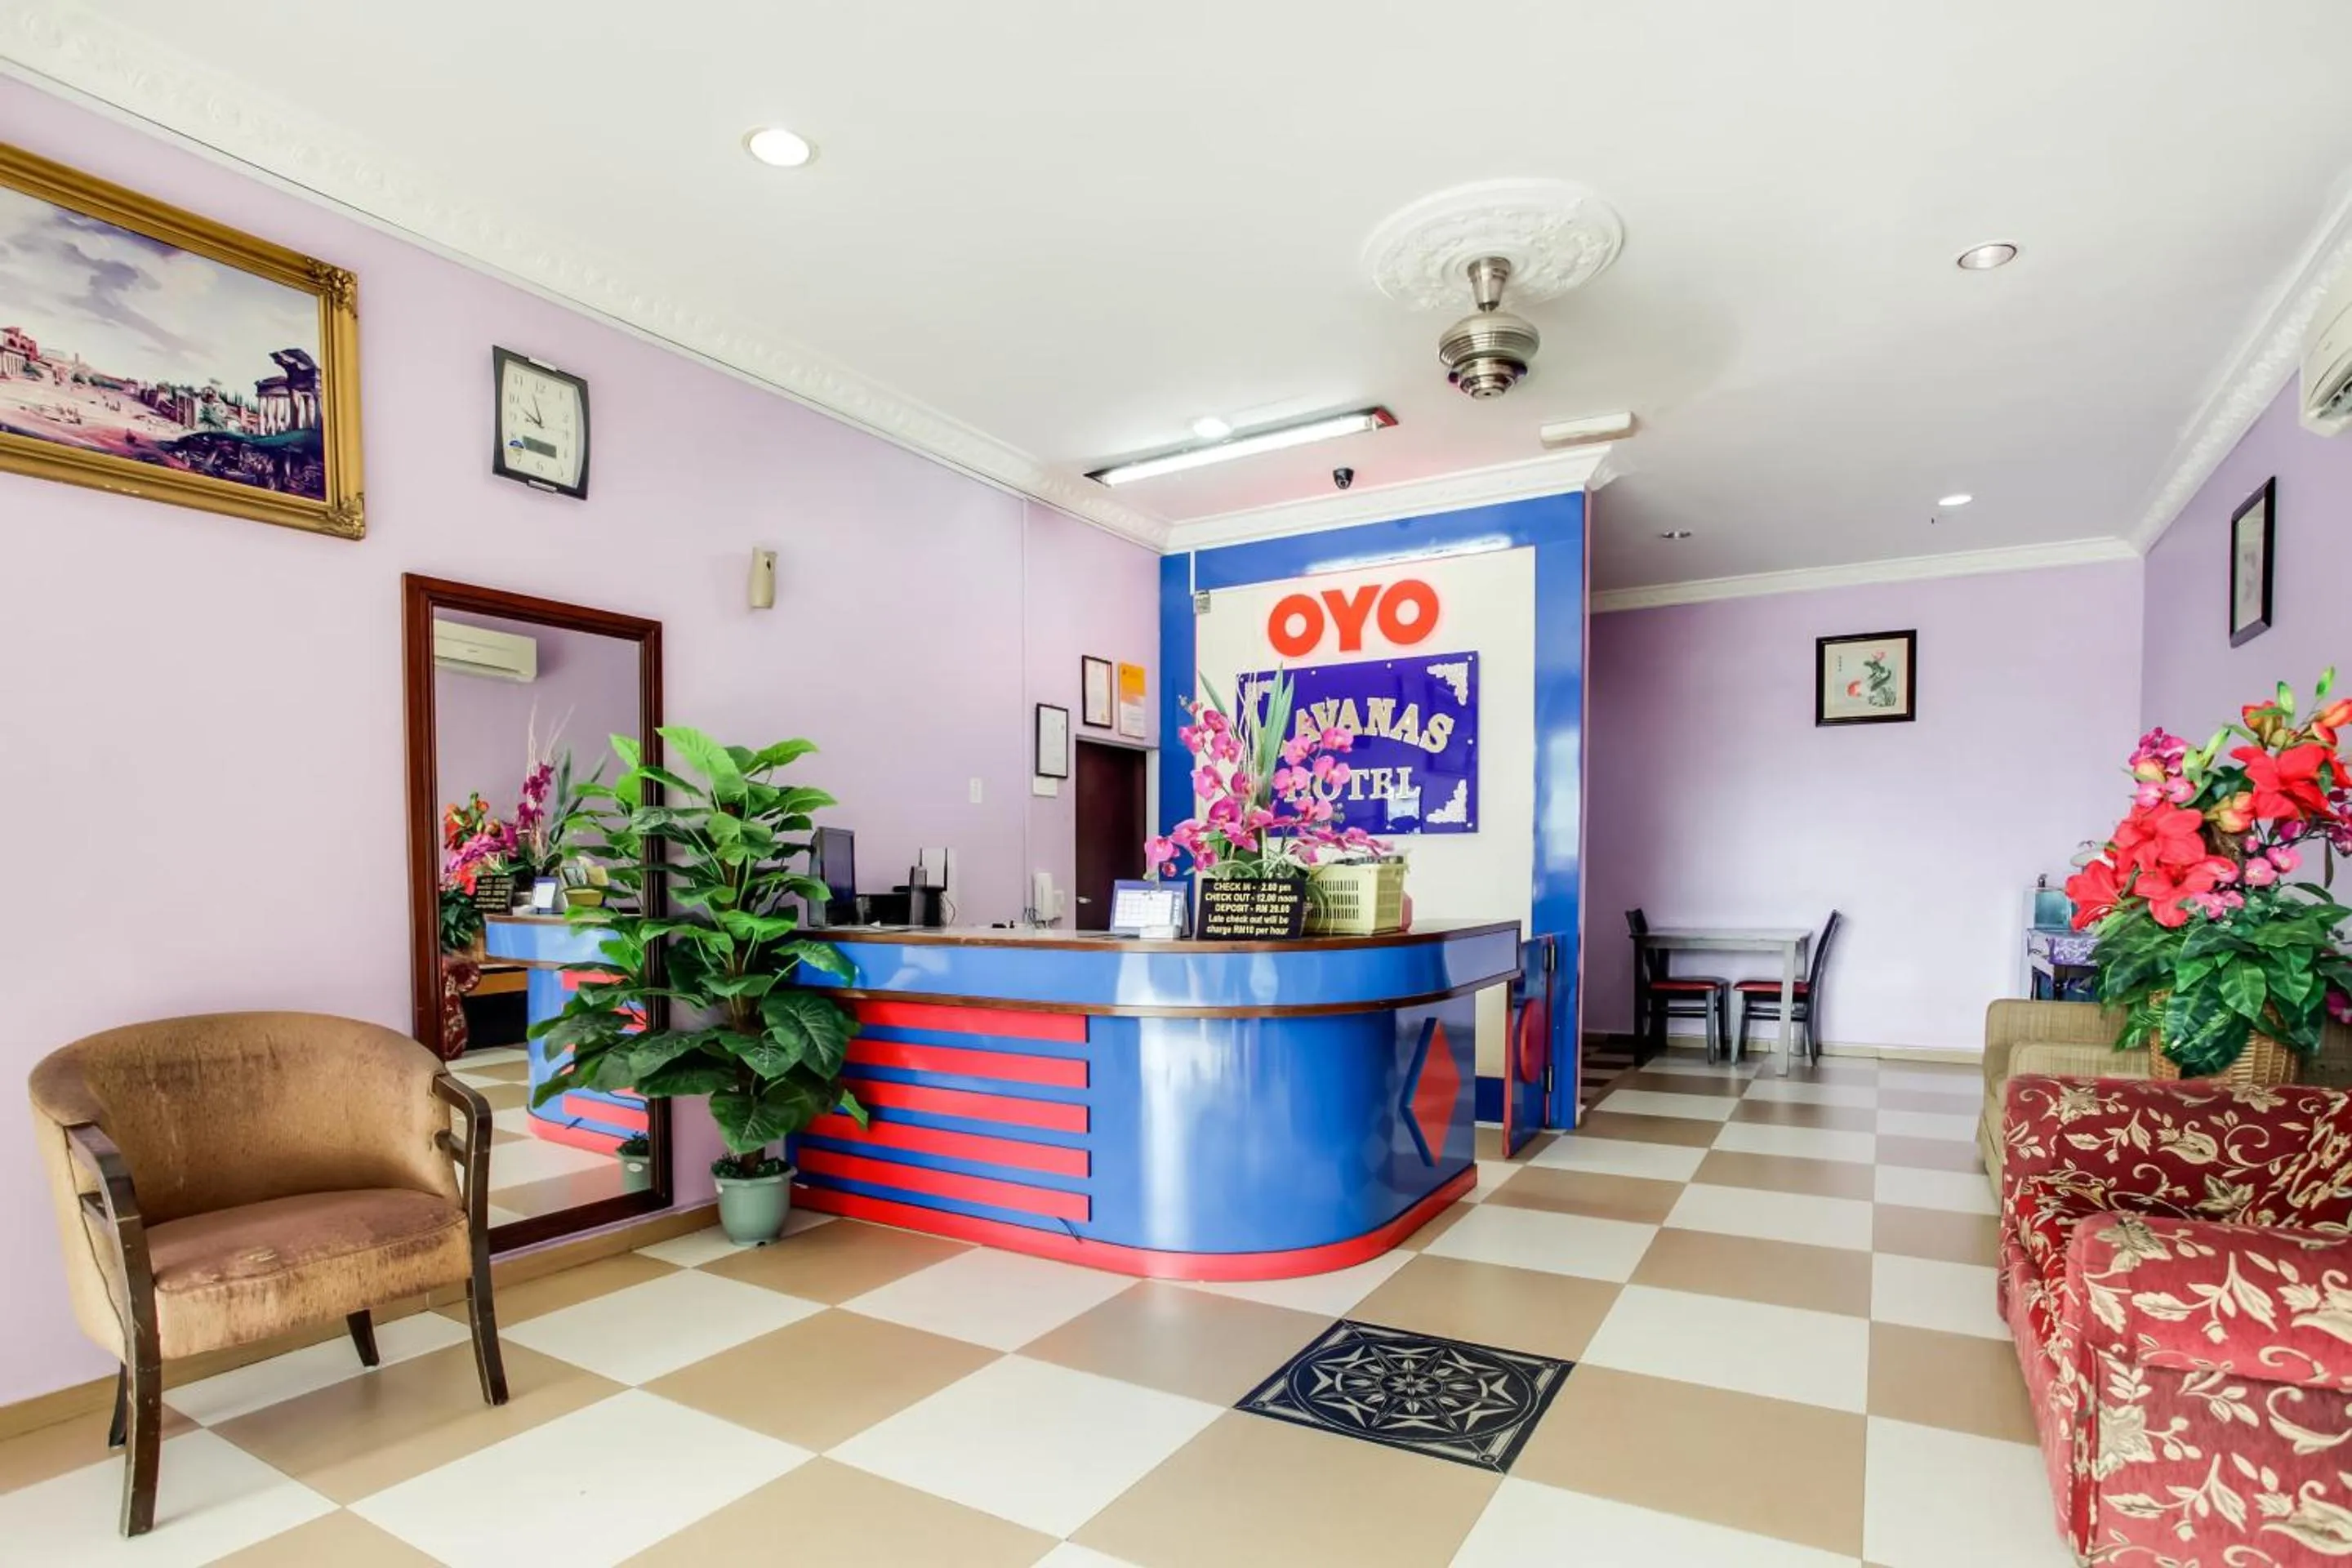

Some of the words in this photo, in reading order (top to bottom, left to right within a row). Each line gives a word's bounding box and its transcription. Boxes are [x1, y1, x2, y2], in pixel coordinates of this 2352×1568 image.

[1268, 579, 1440, 657] OYO
[1279, 697, 1455, 753] AVANAS
[1214, 882, 1241, 892] CHECK
[1242, 883, 1251, 892] IN
[1205, 893, 1232, 902] CHECK
[1233, 893, 1250, 902] OUT
[1277, 895, 1298, 903] noon
[1214, 903, 1250, 912] DEPOSIT
[1255, 904, 1268, 913] RM
[1208, 914, 1225, 923] Late
[1226, 914, 1248, 923] check
[1250, 915, 1263, 924] out
[1263, 915, 1278, 924] will
[1279, 915, 1290, 924] be
[1206, 924, 1232, 935] charge
[1255, 927, 1269, 936] per
[1269, 926, 1290, 935] hour
